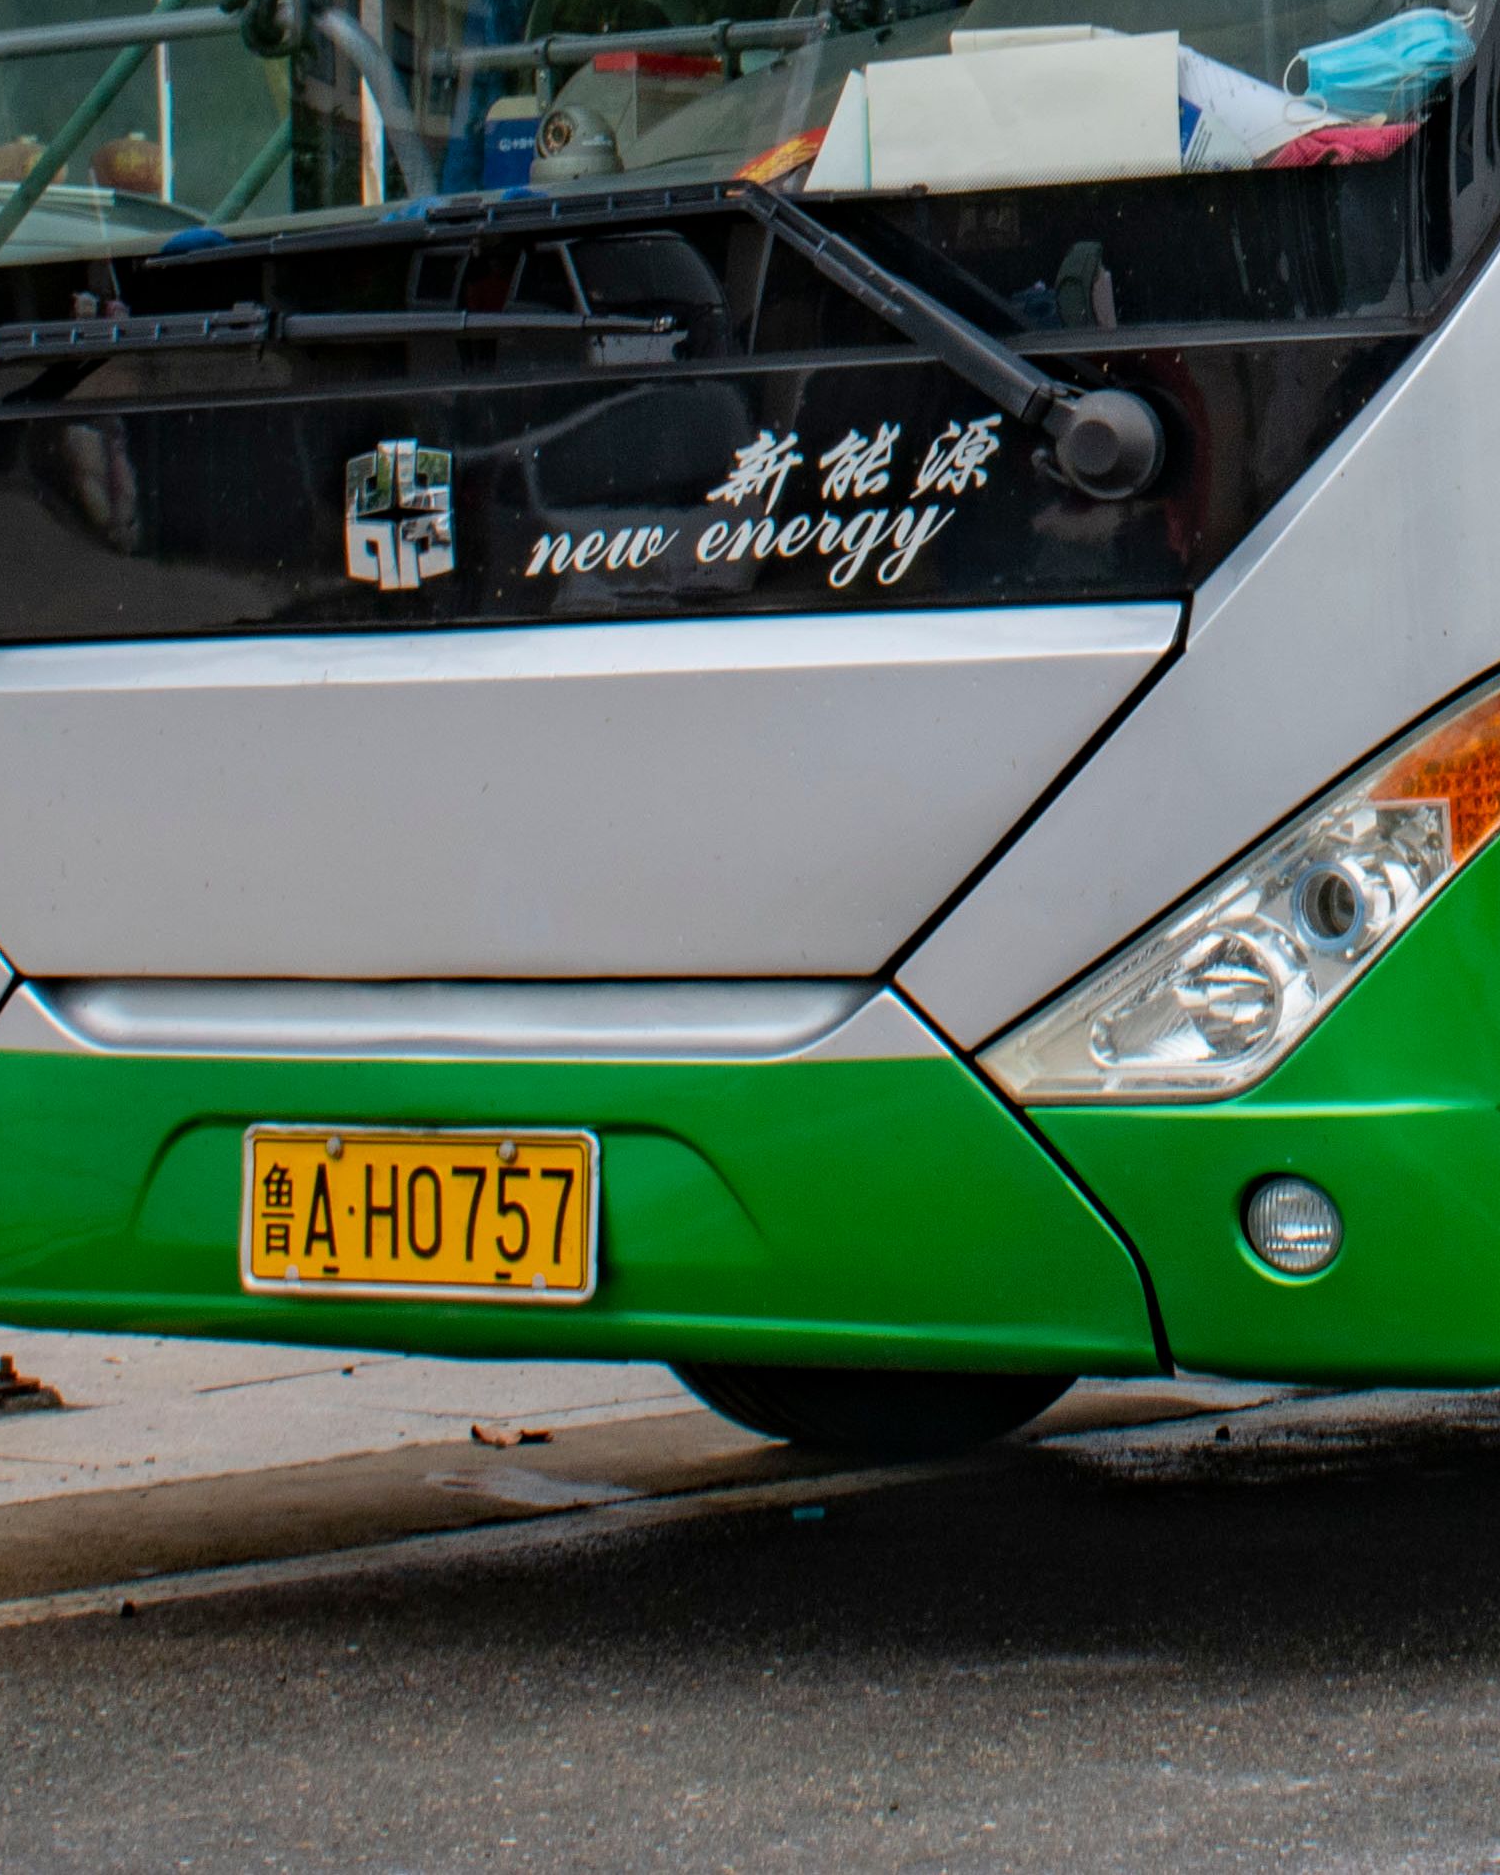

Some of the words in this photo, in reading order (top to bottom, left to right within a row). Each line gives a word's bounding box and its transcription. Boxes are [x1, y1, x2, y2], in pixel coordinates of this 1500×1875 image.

[707, 413, 1002, 509] 新能源
[526, 527, 678, 578] new
[695, 505, 955, 588] energy
